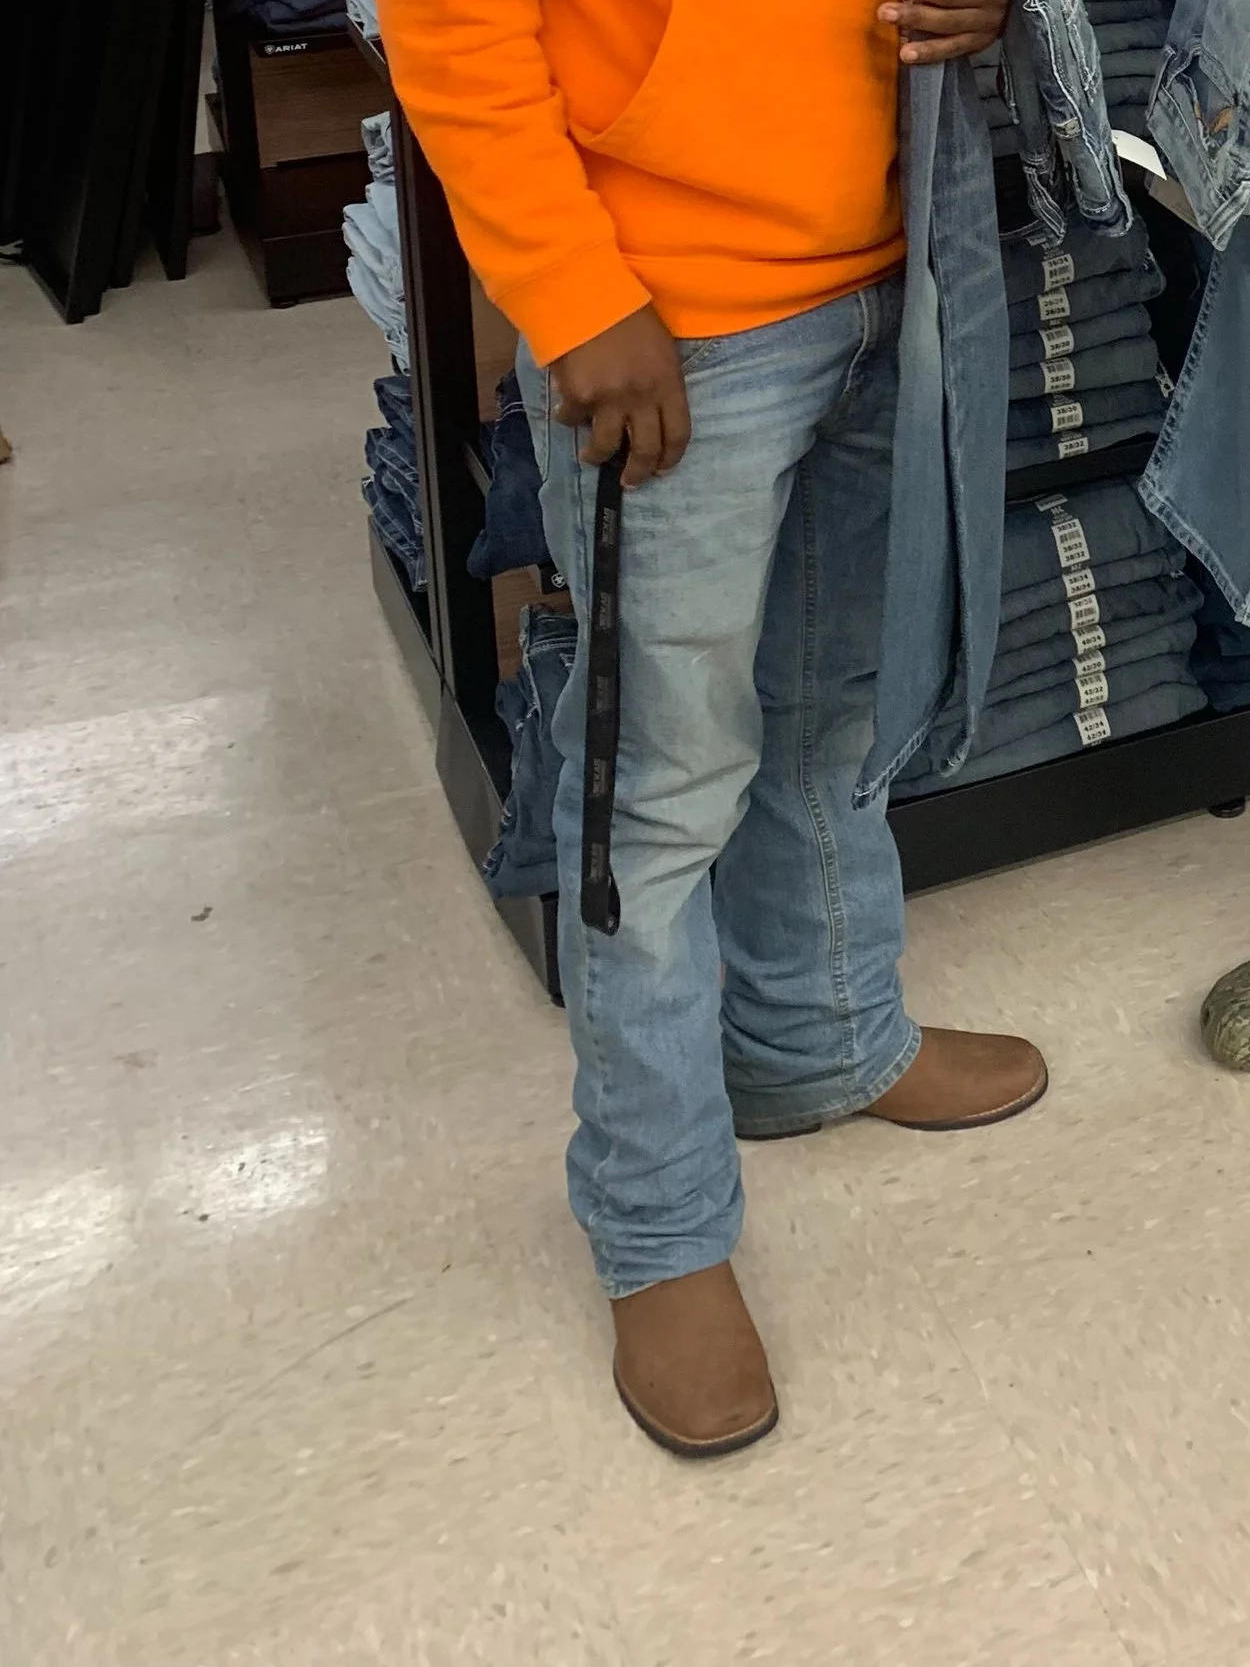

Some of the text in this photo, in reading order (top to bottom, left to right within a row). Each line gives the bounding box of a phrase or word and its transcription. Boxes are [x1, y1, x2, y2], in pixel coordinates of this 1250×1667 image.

[275, 42, 308, 53] ARIAT
[1063, 440, 1084, 451] 38/32
[1081, 661, 1102, 672] 42/30
[1083, 685, 1104, 696] 42/32
[1083, 720, 1105, 732] 42/34
